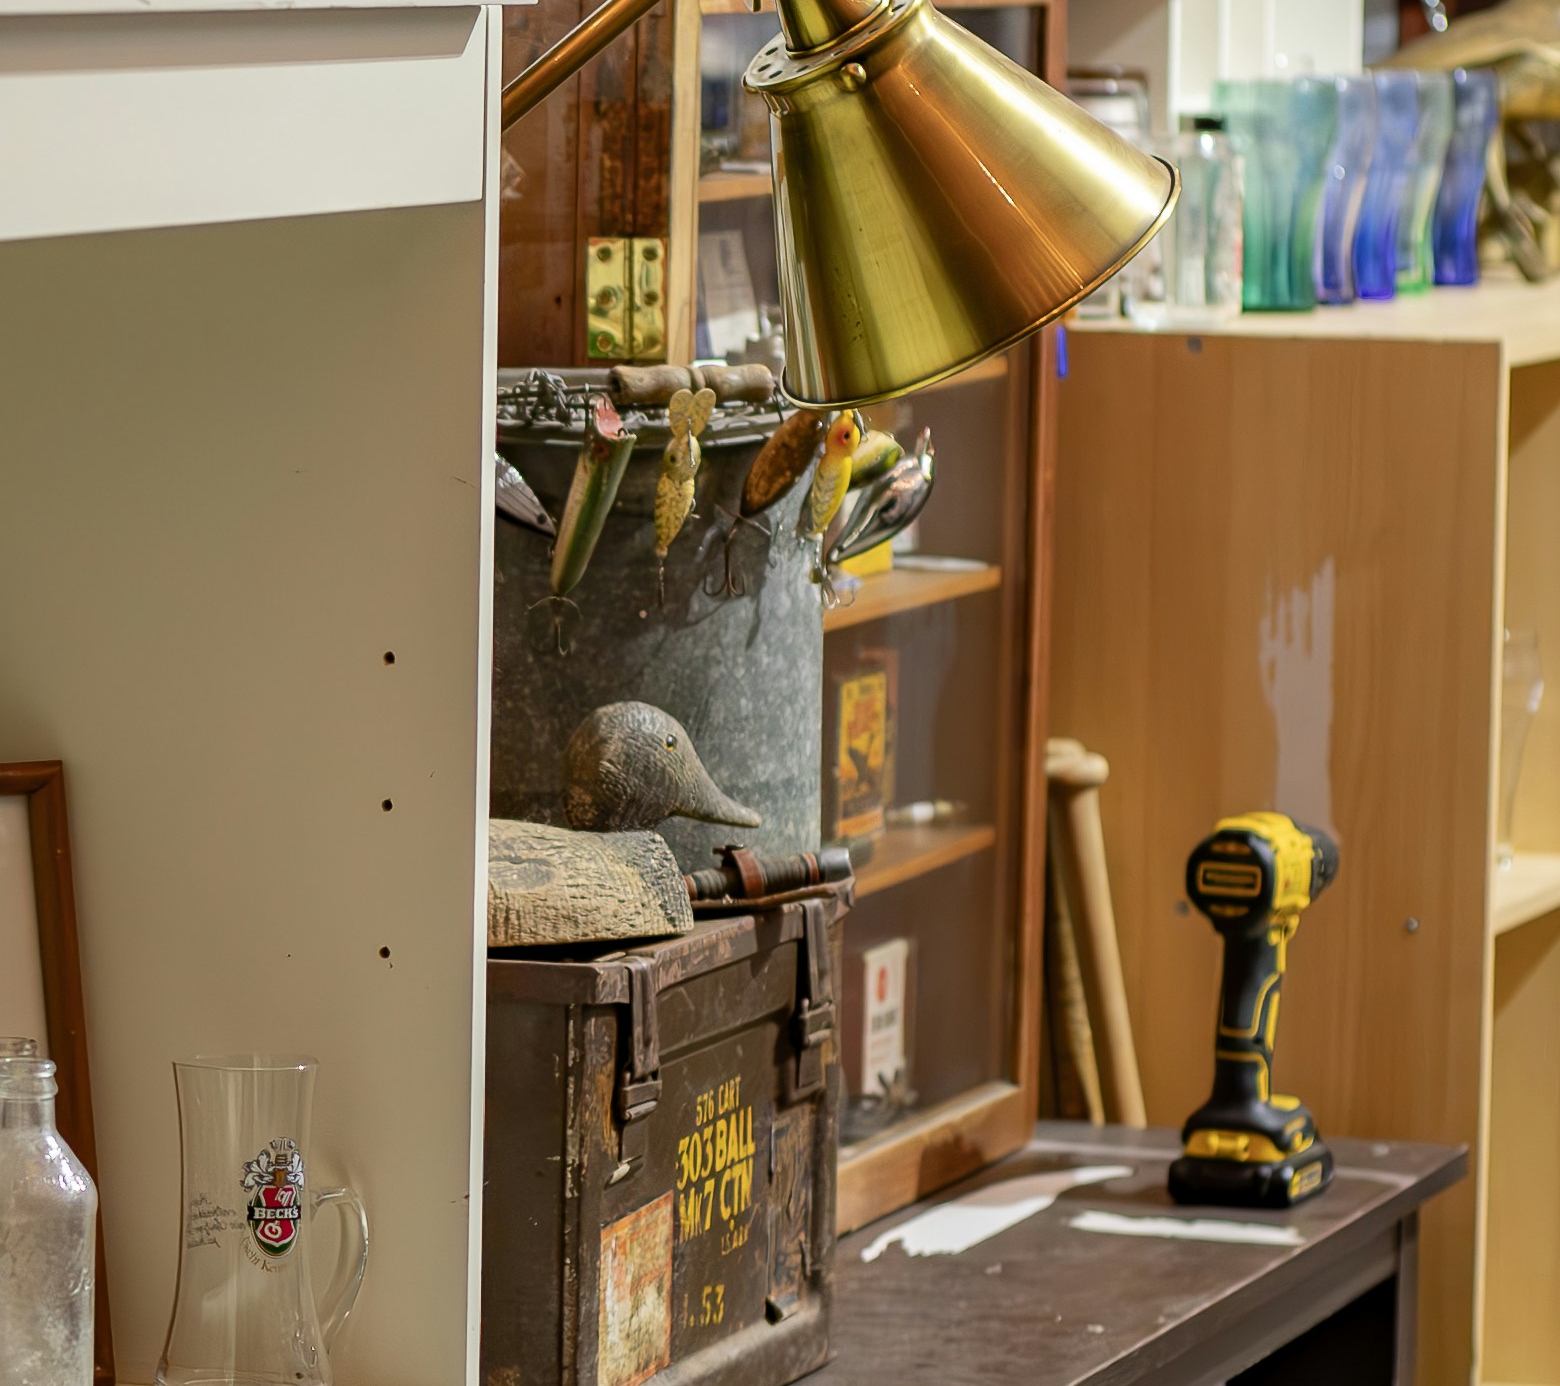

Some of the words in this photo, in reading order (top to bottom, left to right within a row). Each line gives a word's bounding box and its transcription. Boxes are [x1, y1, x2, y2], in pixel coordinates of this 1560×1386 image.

[695, 1094, 715, 1128] 576
[718, 1076, 742, 1115] CART
[714, 1105, 756, 1173] BALL
[719, 1164, 754, 1221] CTN
